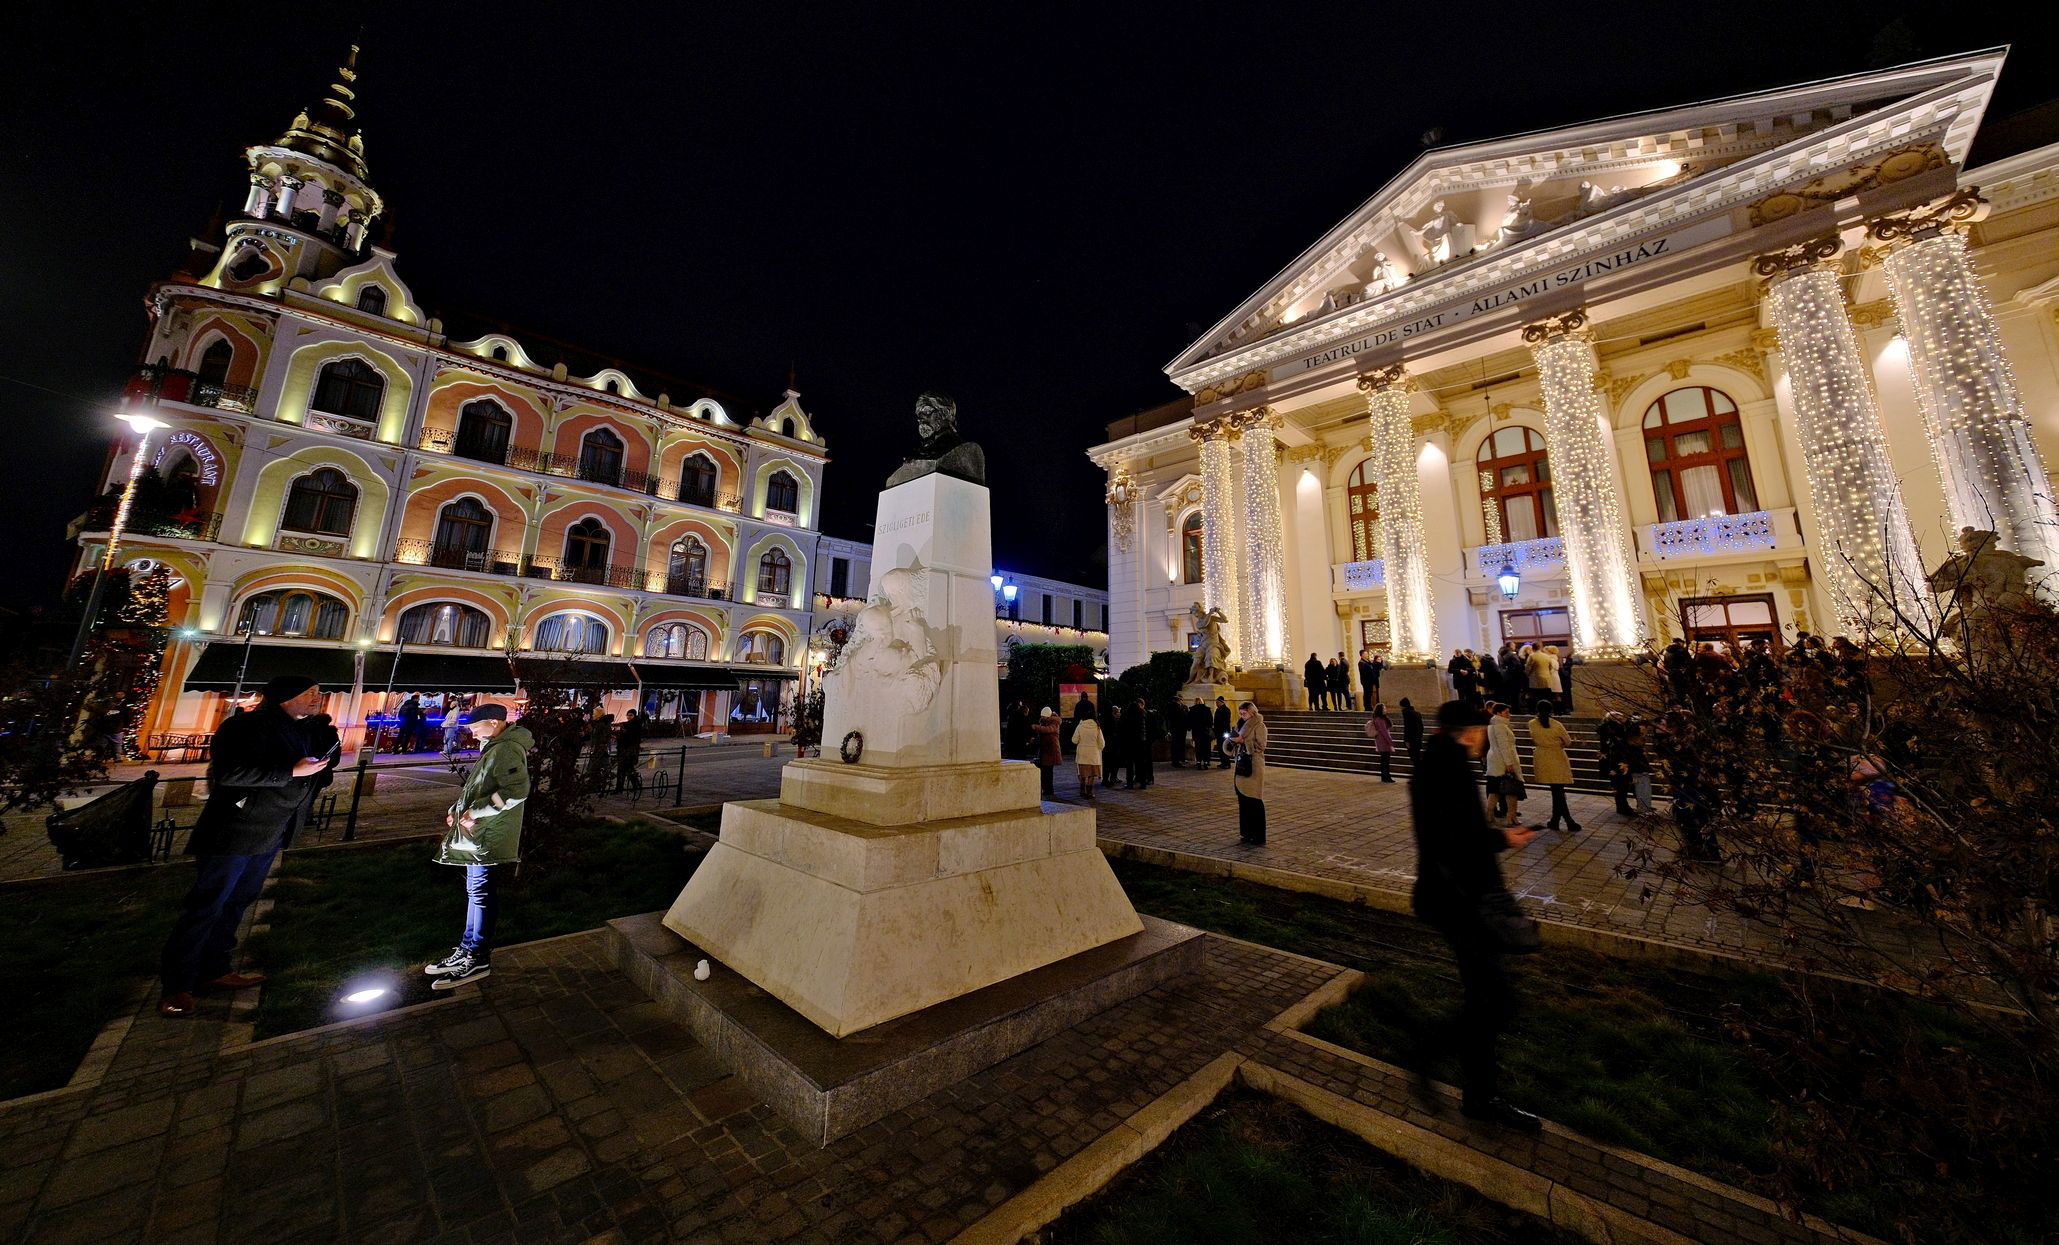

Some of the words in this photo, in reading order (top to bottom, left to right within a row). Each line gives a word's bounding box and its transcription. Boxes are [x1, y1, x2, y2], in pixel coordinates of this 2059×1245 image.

[1303, 340, 1373, 368] TEATRUL
[1375, 331, 1398, 346] DE
[1403, 314, 1445, 337] STAT
[1470, 279, 1549, 315] ÁLLAMI
[1556, 238, 1669, 286] SZÍNHÁZ
[170, 433, 218, 486] RESTAURANT
[916, 511, 931, 525] EDE
